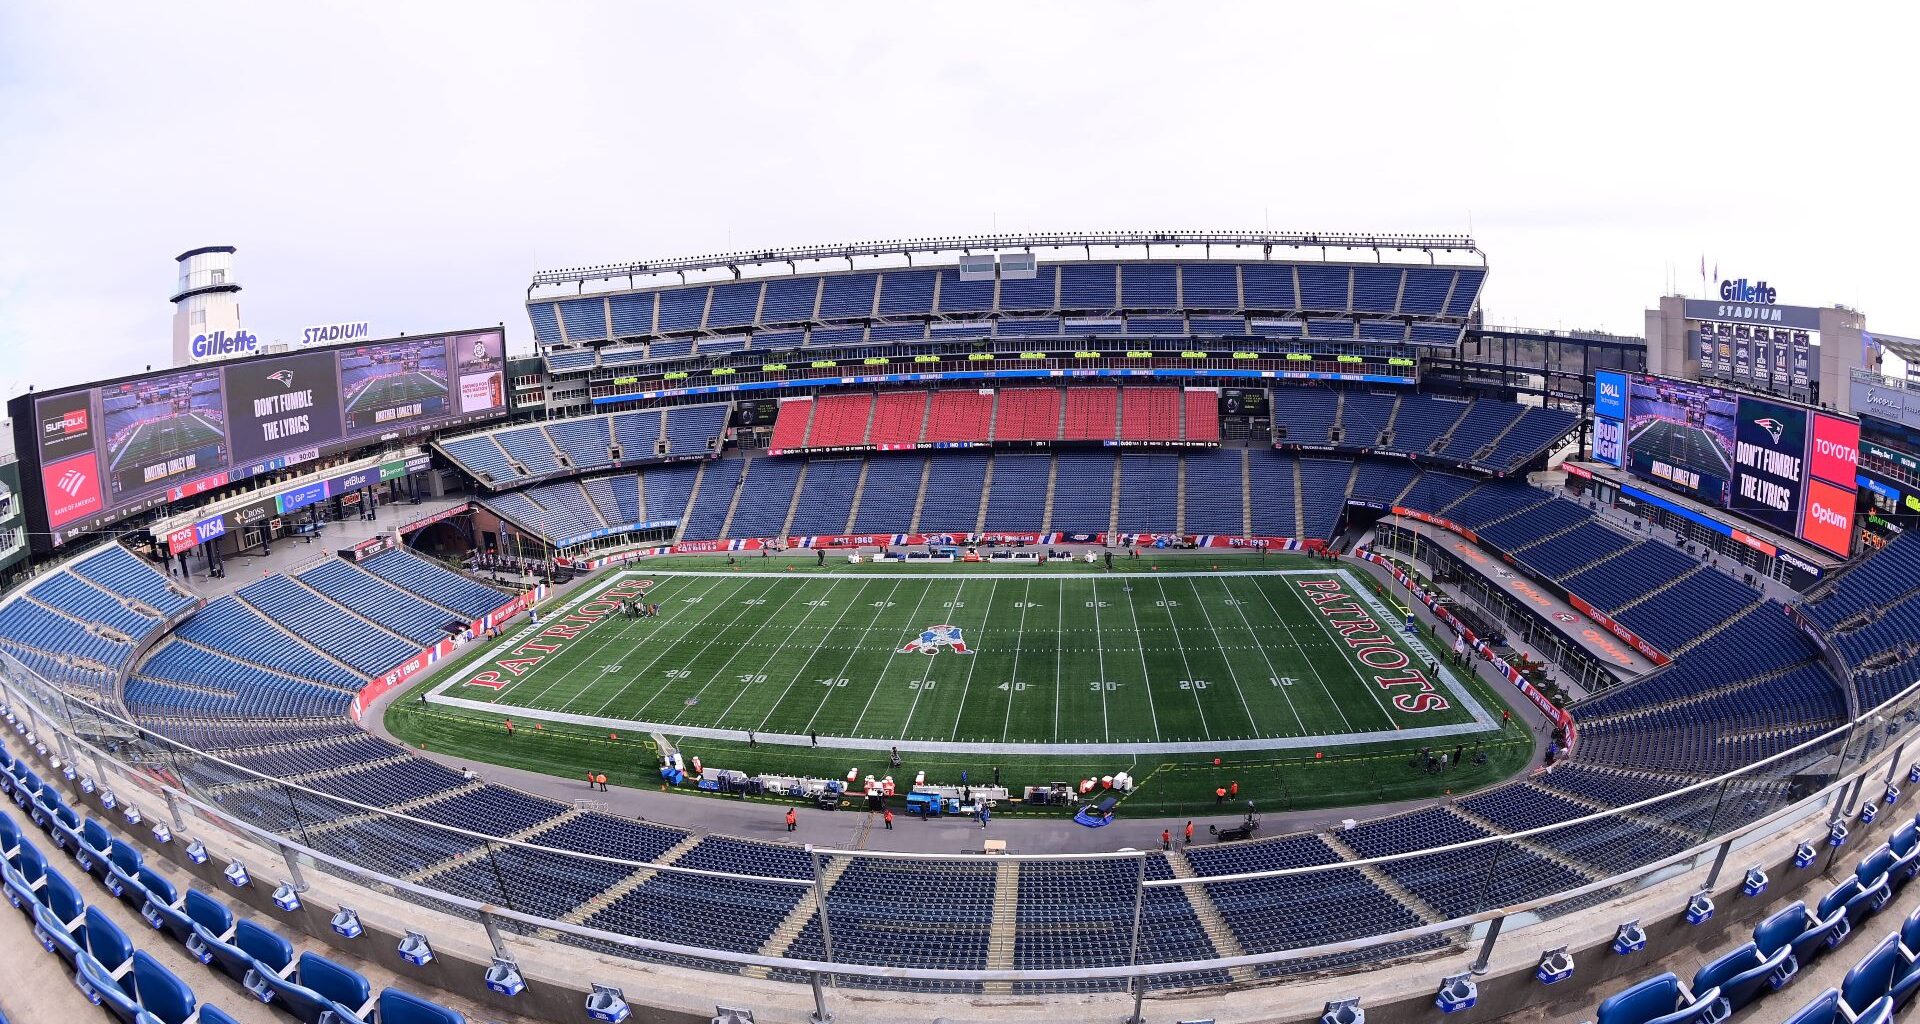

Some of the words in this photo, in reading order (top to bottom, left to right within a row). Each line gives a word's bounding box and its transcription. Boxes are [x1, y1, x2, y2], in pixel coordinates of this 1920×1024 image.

[1720, 279, 1777, 304] Gillette
[1718, 305, 1782, 322] STADIUM
[303, 323, 368, 344] STADIUM
[192, 331, 257, 357] Gillette
[863, 357, 890, 365] Gillette
[1286, 353, 1312, 361] Gillette
[1337, 355, 1363, 363] Gillette
[1388, 358, 1414, 366] Gillette
[614, 377, 638, 385] Gillette
[1600, 383, 1620, 398] DELL
[254, 397, 279, 418] DON'T
[280, 389, 313, 412] FUMBLE
[1867, 388, 1901, 410] Encore
[45, 416, 84, 433] SUFFOLK
[262, 421, 280, 441] THE
[280, 414, 310, 438] LYRICS
[1599, 422, 1618, 442] BUD
[299, 450, 316, 461] 90:00
[1595, 440, 1620, 460] LIGHT
[1816, 438, 1857, 464] TOYOTA
[252, 464, 265, 475] IND
[270, 461, 275, 470] 0
[1736, 440, 1763, 470] DON'T
[1762, 449, 1801, 482] FUMBLE
[144, 462, 168, 481] ANOTHER
[1651, 461, 1672, 479] ANOTHER
[196, 482, 206, 491] NE
[343, 475, 366, 489] jetBlue
[295, 493, 305, 502] GP
[1740, 474, 1757, 500] THE
[1757, 478, 1790, 512] LYRICS
[1404, 508, 1420, 519] Optum
[1427, 515, 1445, 525] Optum
[1449, 523, 1462, 535] Optum
[1812, 502, 1847, 530] Optum
[67, 528, 79, 538] 0:00
[176, 530, 192, 541] CVS
[197, 519, 225, 539] VISA
[174, 539, 194, 553] Health
[677, 541, 717, 552] PATRIOTS
[854, 536, 873, 544] 1960
[1745, 535, 1761, 548] Optum
[1791, 557, 1819, 576] EMPOWER
[463, 578, 654, 691] PATRIOTS
[1589, 608, 1607, 625] Optum
[1613, 624, 1631, 642] Optum
[1638, 641, 1658, 660] Optum
[1297, 578, 1450, 713] PATRIOTS
[403, 659, 420, 676] 1960
[606, 664, 623, 673] 10
[667, 669, 692, 679] 20
[740, 674, 768, 684] 30
[822, 678, 849, 687] 40
[909, 680, 936, 690] 50
[997, 681, 1027, 691] 40
[1090, 681, 1118, 691] 30
[1179, 680, 1207, 690] 20
[1270, 677, 1294, 687] 10
